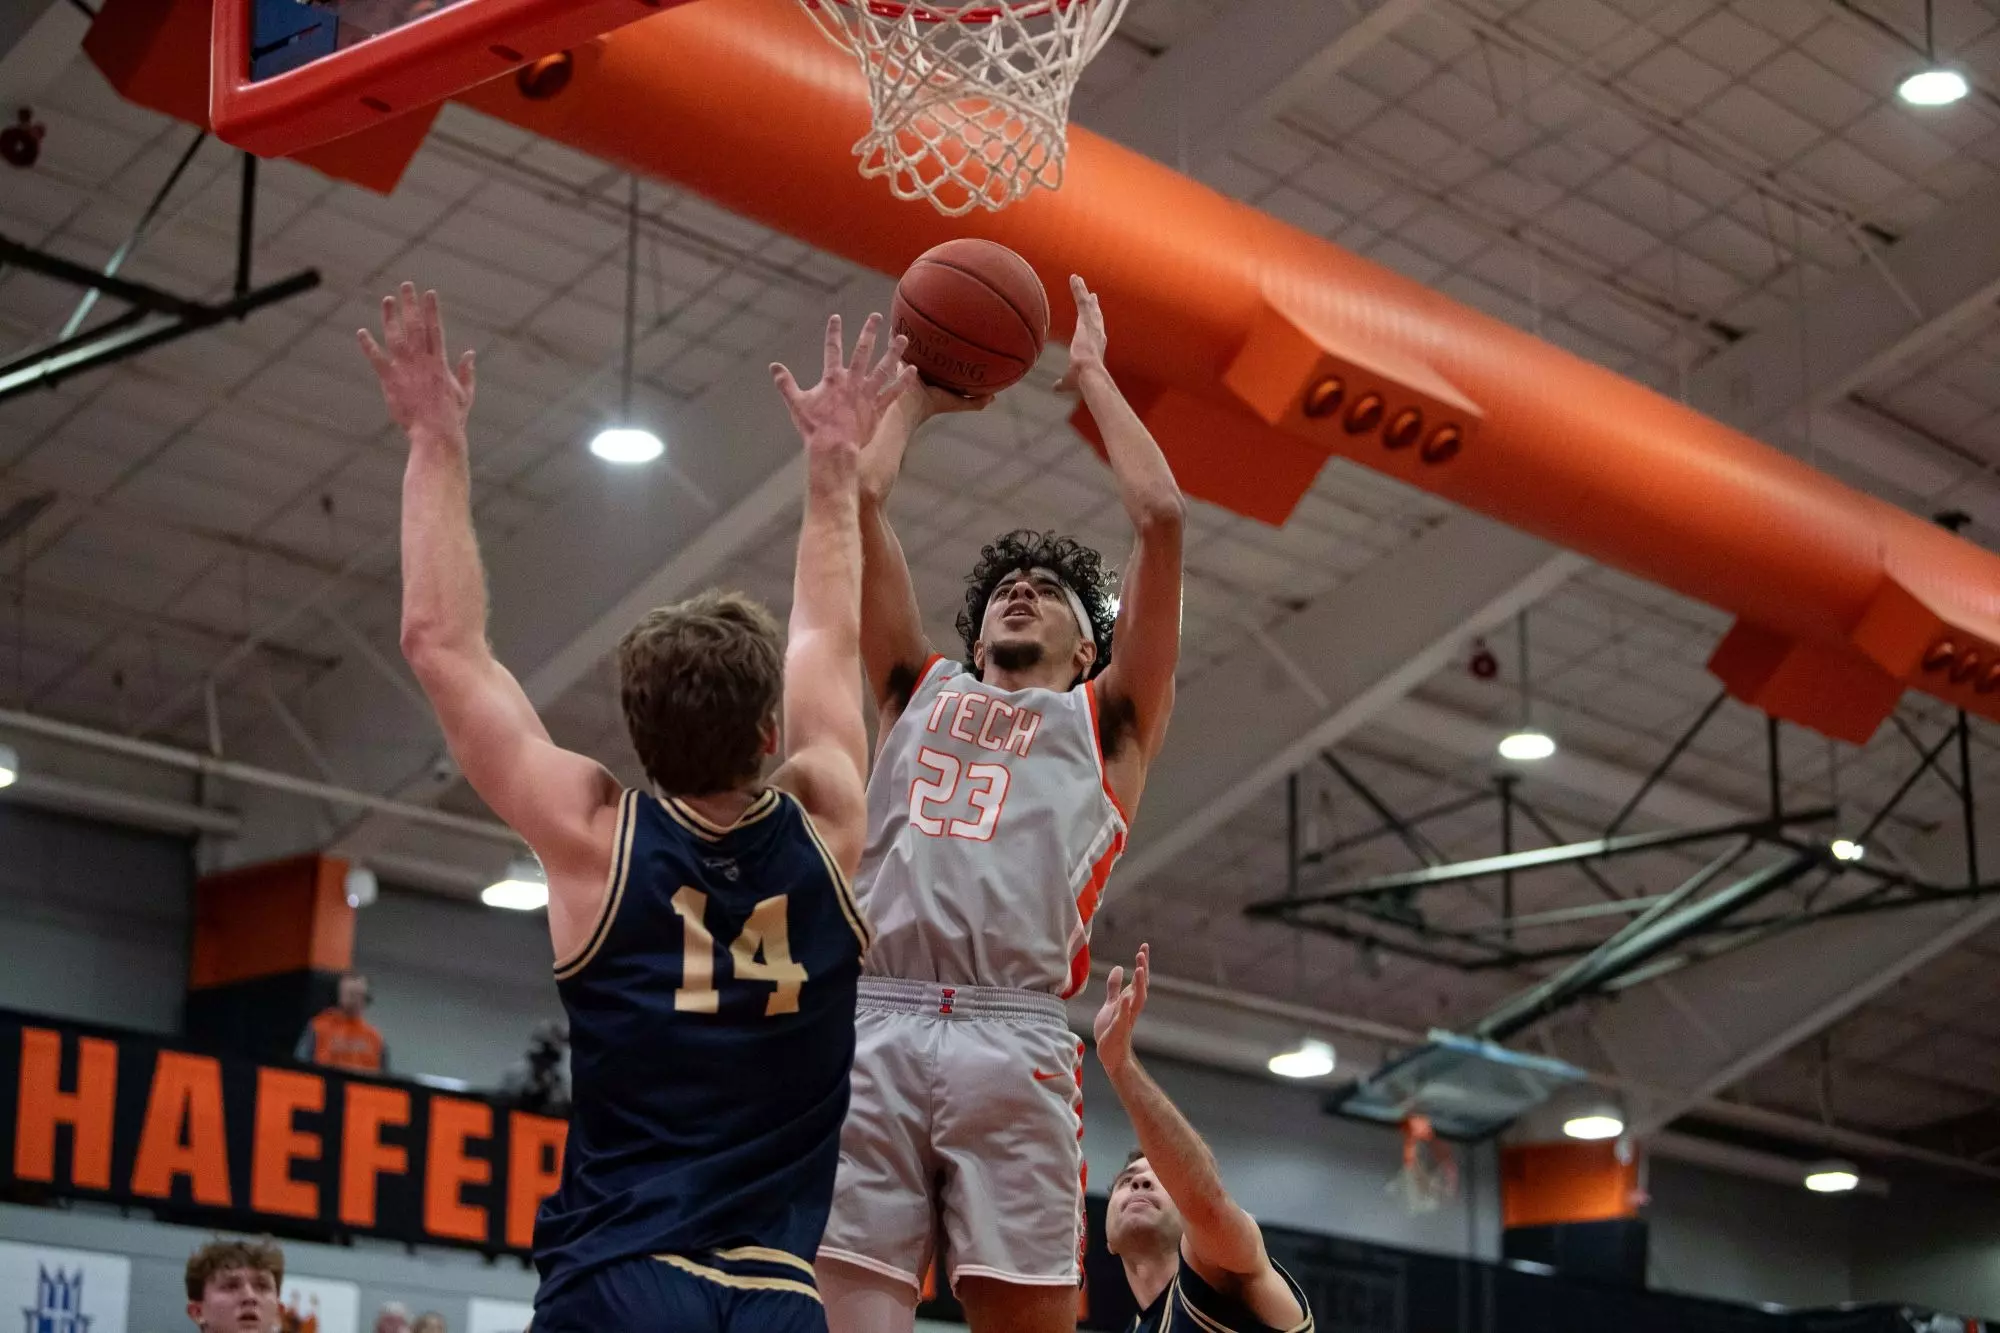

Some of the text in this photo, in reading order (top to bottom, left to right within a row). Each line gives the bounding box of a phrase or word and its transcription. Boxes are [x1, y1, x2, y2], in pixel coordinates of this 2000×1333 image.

[927, 690, 1041, 757] TECH
[909, 747, 1010, 841] 23
[671, 885, 808, 1016] 14
